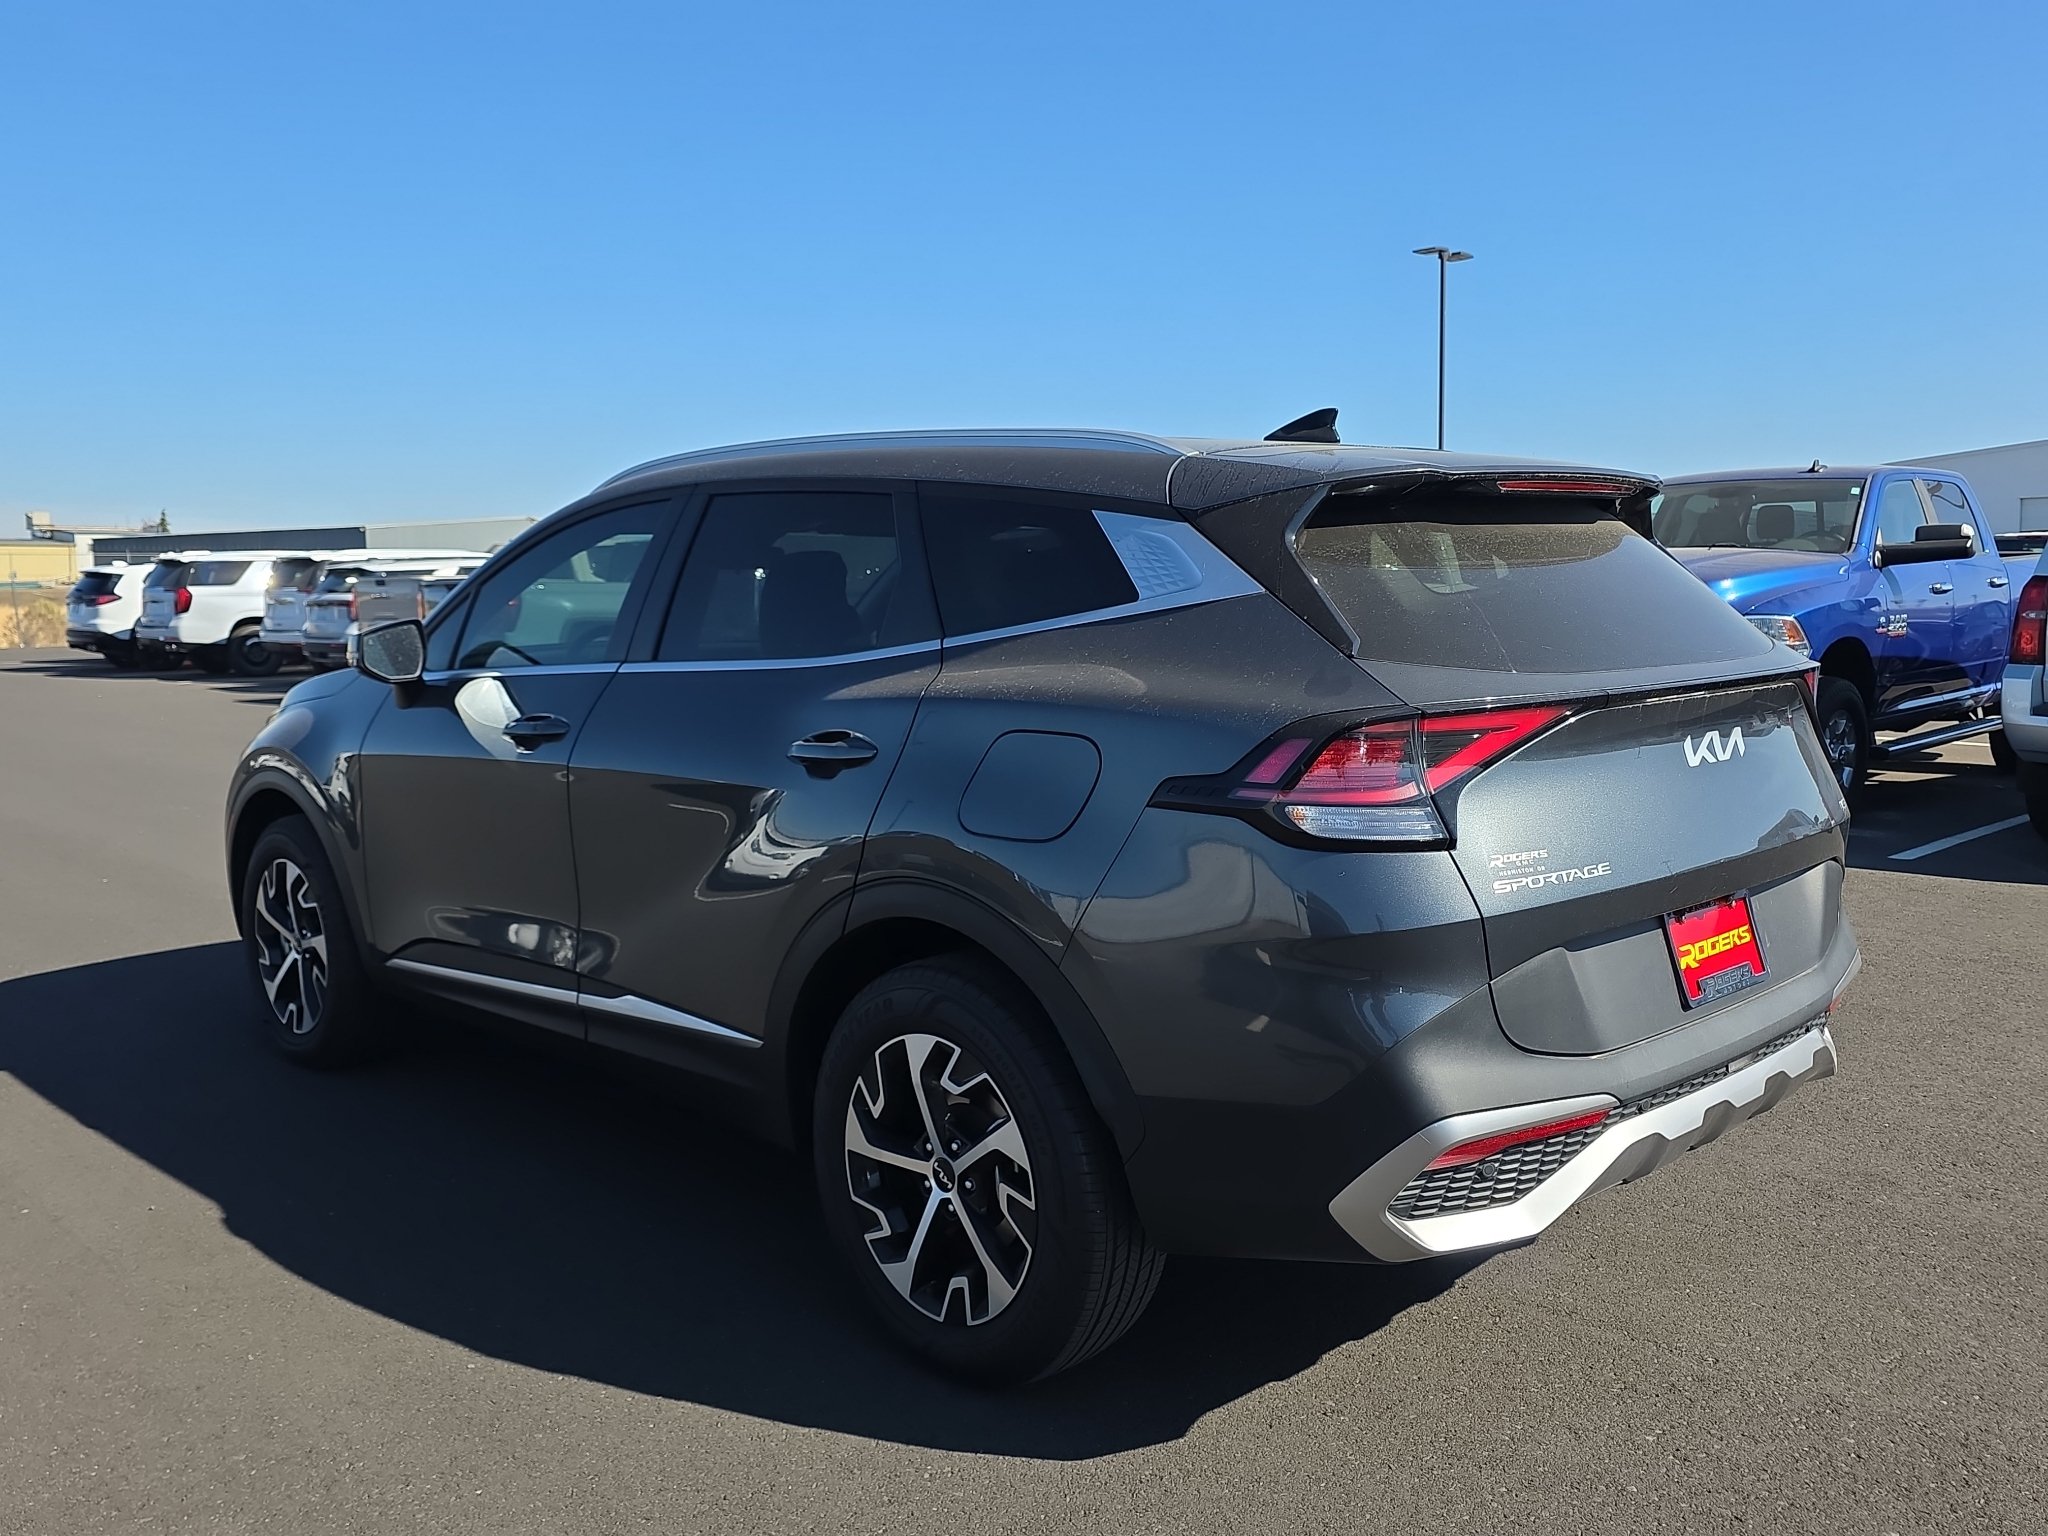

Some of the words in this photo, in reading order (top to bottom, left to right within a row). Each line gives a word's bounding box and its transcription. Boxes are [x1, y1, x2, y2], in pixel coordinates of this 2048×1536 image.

[1489, 848, 1549, 868] ROGERS
[1492, 861, 1613, 895] SPORTAGE
[1679, 924, 1751, 970] ROGERS
[1705, 965, 1752, 999] ROGERS
